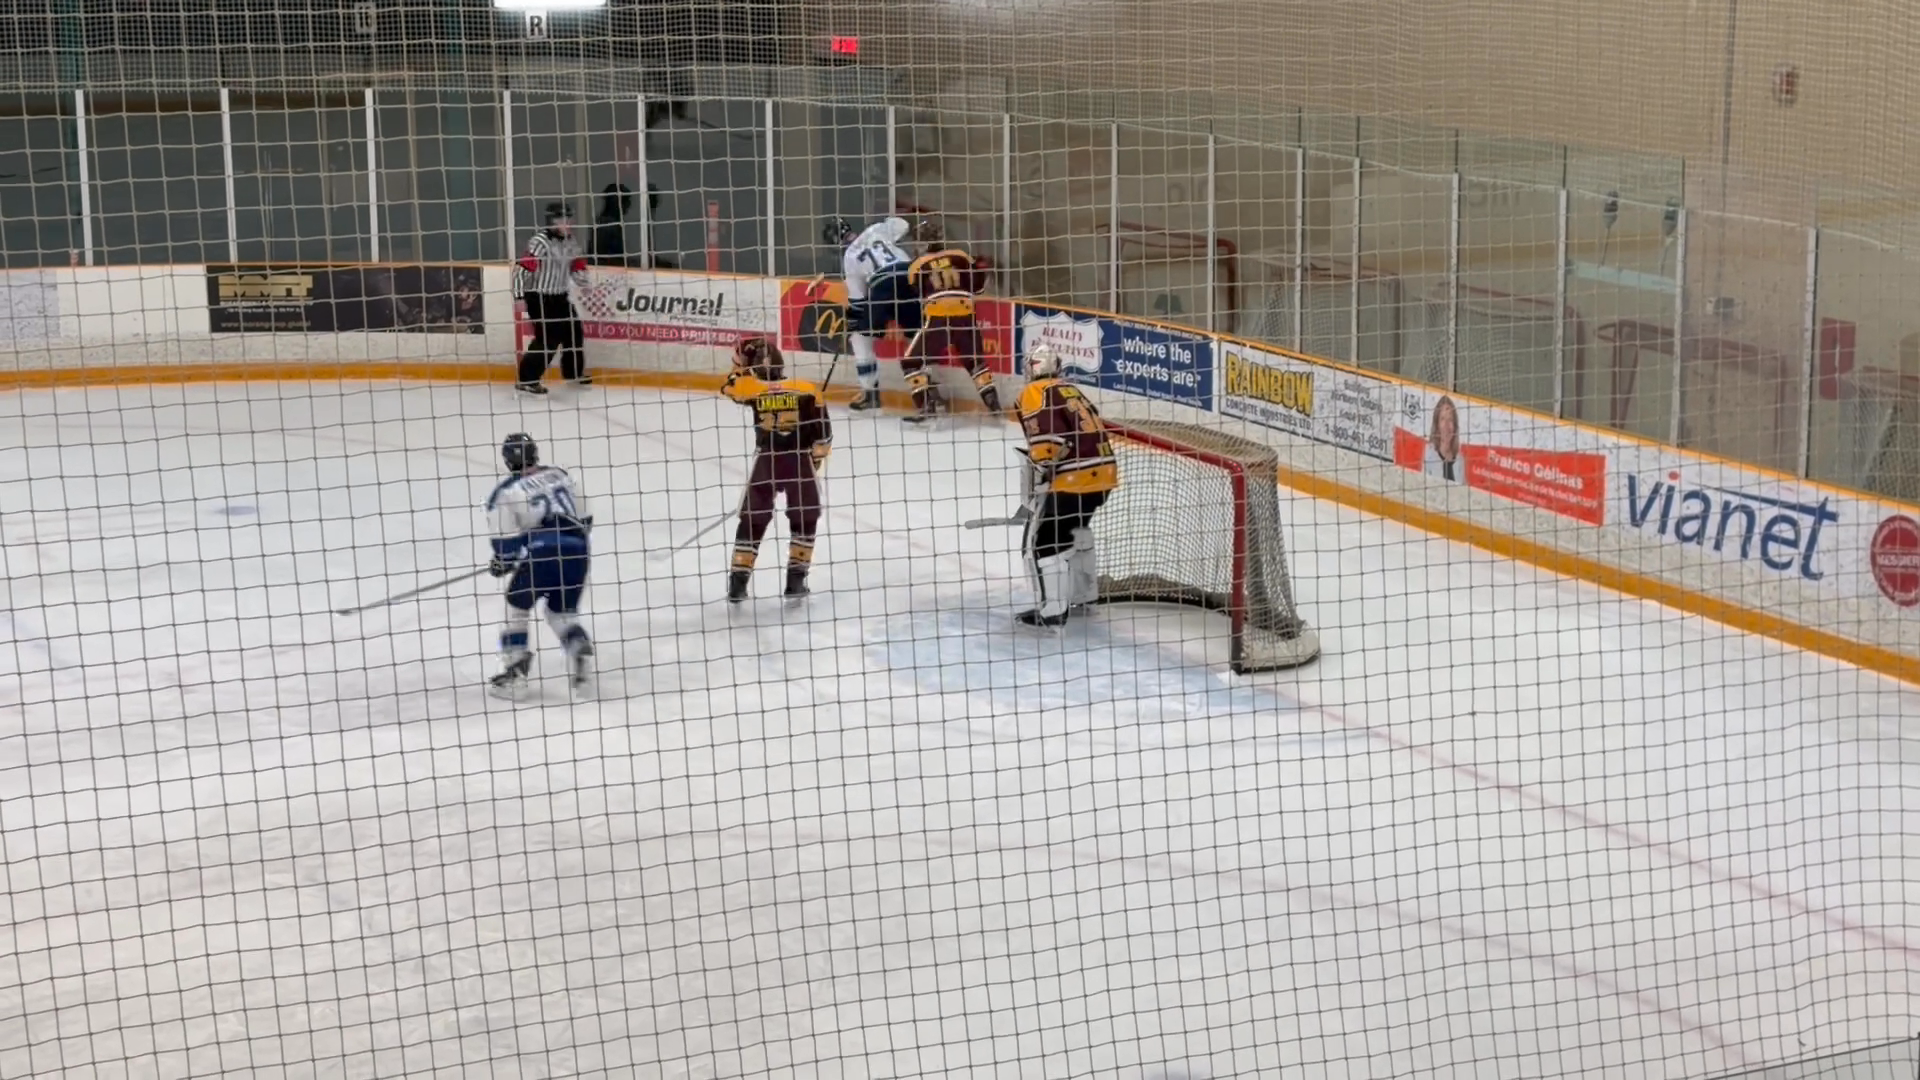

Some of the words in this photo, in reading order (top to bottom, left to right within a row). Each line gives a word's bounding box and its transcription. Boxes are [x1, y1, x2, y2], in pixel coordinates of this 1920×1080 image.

[530, 15, 544, 36] R
[857, 240, 898, 270] 73
[616, 288, 724, 317] Journal
[620, 325, 644, 338] YOU
[647, 327, 679, 340] NEED
[1042, 327, 1084, 342] REALTY
[1124, 336, 1167, 358] where
[1170, 343, 1192, 364] the
[1116, 359, 1169, 382] experts
[1226, 350, 1315, 418] RAINBOW
[1226, 398, 1258, 416] CONCRETE
[1488, 448, 1531, 475] France
[531, 486, 578, 520] 20
[1628, 470, 1840, 581] vianet
